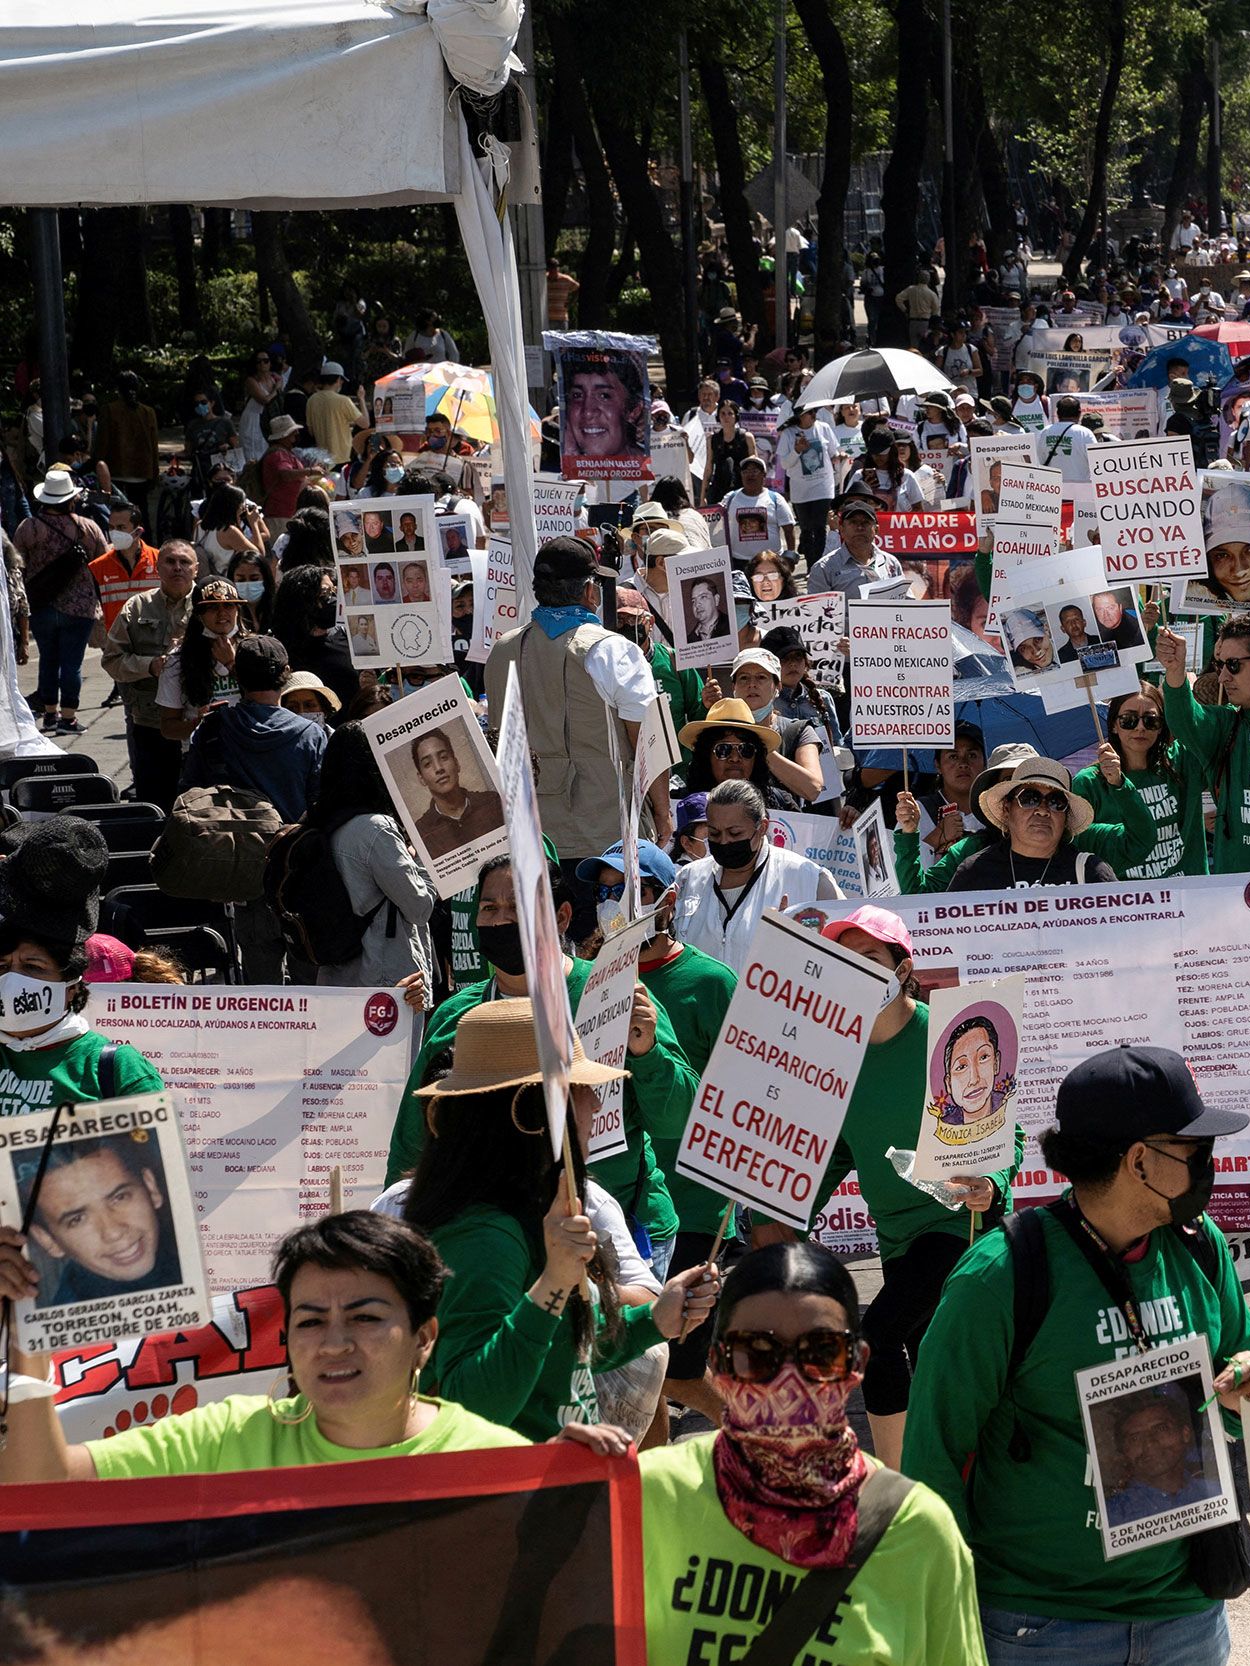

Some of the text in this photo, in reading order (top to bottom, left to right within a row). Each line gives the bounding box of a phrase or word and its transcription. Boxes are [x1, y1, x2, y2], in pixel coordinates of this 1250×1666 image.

[976, 443, 1031, 453] Desaparecido
[1093, 451, 1190, 475] ¿QUIÉN TE
[578, 470, 641, 478] MEDINA OROZCO
[1002, 478, 1061, 495] GRAN FRACASO
[1095, 471, 1194, 498] BUSCARÁ
[1001, 499, 1059, 514] ESTADO MEXICANO
[1100, 499, 1195, 522] CUANDO
[890, 514, 958, 529] MADRE
[874, 531, 961, 549] DE 1 AÑO
[1117, 525, 1186, 547] ¿YO YA
[996, 541, 1051, 556] COAHUILA
[675, 559, 726, 576] Desaparecido
[1106, 548, 1202, 572] NO ESTÉ?
[896, 614, 903, 622] EL
[853, 626, 948, 639] GRAN FRACASO
[854, 657, 949, 668] ESTADO MEXICANO
[854, 686, 950, 698] NO ENCONTRAR
[855, 704, 950, 716] A NUESTROS AS
[375, 697, 459, 746] Desaparecido
[855, 723, 951, 736] DESAPARECIDOS
[935, 892, 1155, 920] BOLETÍN DE URGENCIA
[974, 910, 1185, 934] LOCALIZADA, AYÚDANOS ENCONTRARLA
[804, 960, 823, 979] EN
[120, 993, 295, 1012] BOLETÍN DE URGENCIA
[368, 1006, 395, 1018] FGJ
[745, 962, 864, 1044] COAHUILA
[257, 1021, 317, 1030] ENCONTRARLA
[781, 1022, 798, 1040] LA
[724, 1024, 849, 1100] DESAPARICIÓN
[766, 1085, 781, 1100] ES
[0, 1107, 168, 1148] DESAPARECIDO
[699, 1083, 828, 1165] EL CRIMEN
[940, 1126, 972, 1139] MÓNICA
[687, 1122, 813, 1202] PERFECTO
[934, 1152, 973, 1161] DESAPARECIÓ
[978, 1153, 1000, 1162] COAHUILA
[24, 1286, 196, 1323] CARLOS GERARDO GARCIA ZAPATA
[41, 1302, 183, 1334] TORREON, COAH.
[28, 1311, 200, 1351] 31 DE OCTUBRE DE 2008
[1090, 1350, 1190, 1387] DESAPARECIDO
[1085, 1360, 1201, 1401] SANTANA CRUZ REYES
[1119, 1498, 1229, 1537] DE NOVIEMBRE 2010
[1111, 1508, 1228, 1548] COMARCA LAGUNERA
